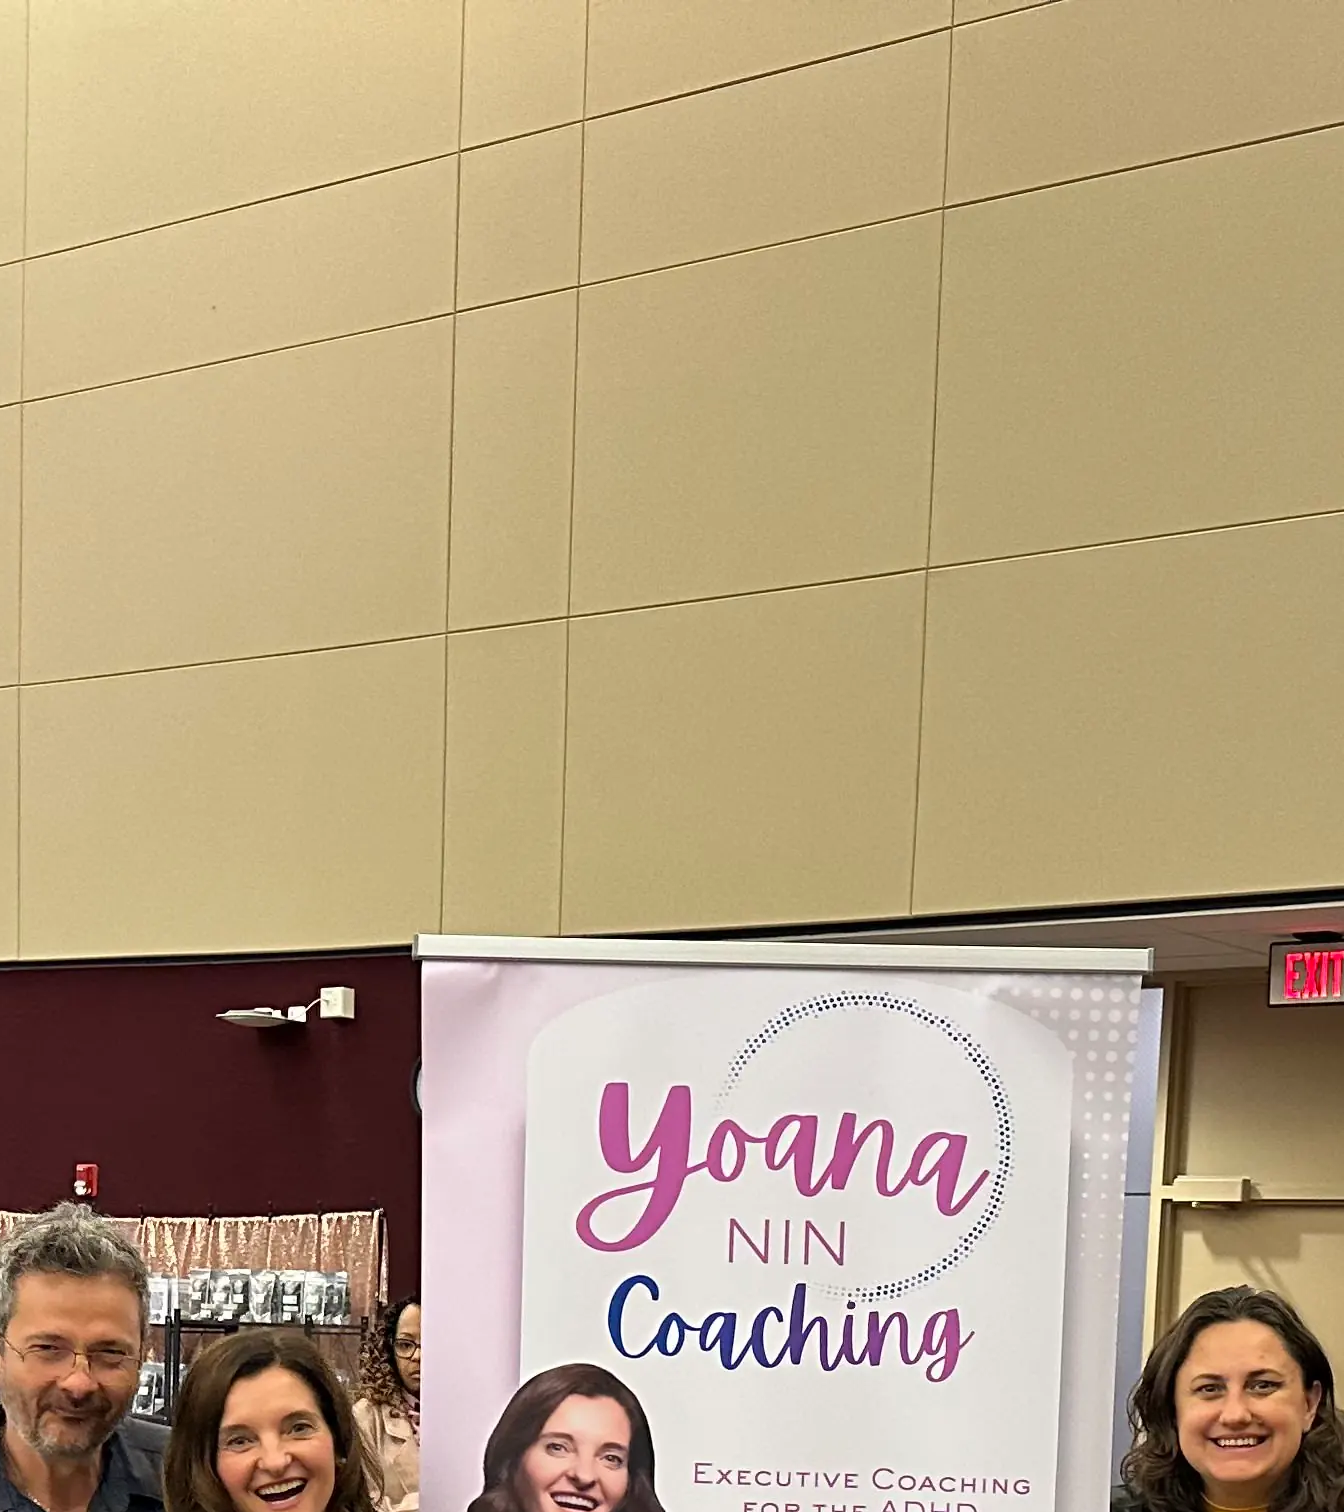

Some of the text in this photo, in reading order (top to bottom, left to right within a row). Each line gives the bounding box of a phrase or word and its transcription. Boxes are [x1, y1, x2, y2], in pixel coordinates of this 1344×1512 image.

[575, 1082, 991, 1253] Yoana
[729, 1219, 846, 1266] NIN
[608, 1274, 975, 1383] Coaching
